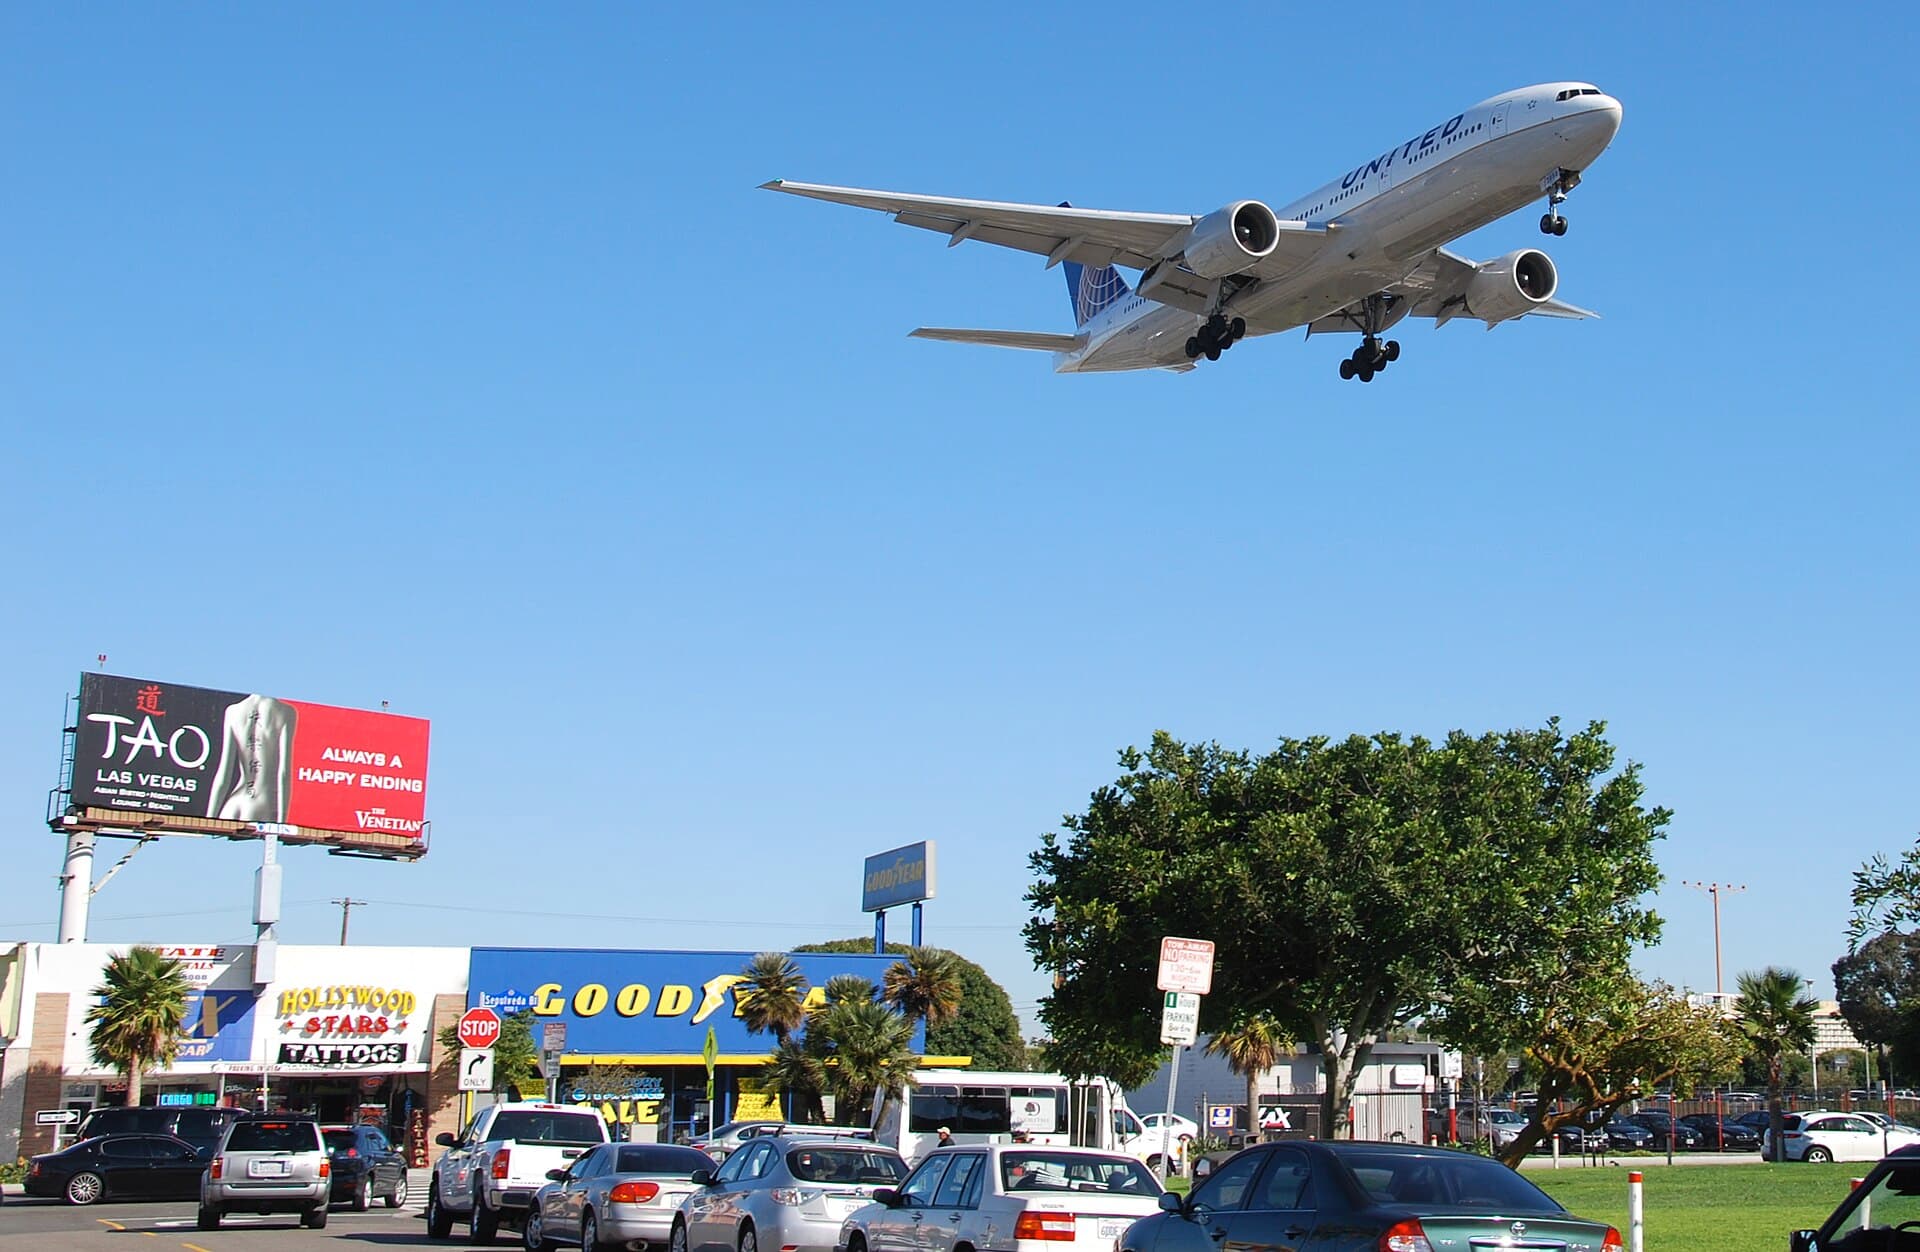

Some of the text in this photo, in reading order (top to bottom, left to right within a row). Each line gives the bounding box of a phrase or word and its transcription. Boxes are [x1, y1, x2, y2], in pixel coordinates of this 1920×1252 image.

[1341, 113, 1464, 190] UNITED
[136, 685, 166, 716] 道
[321, 747, 403, 769] ALWAYS A
[96, 769, 198, 792] LAS VEGAS
[298, 767, 423, 793] HAPPY ENDING
[355, 810, 423, 832] VENETIAN
[1164, 949, 1178, 961] NO
[281, 984, 416, 1015] HOLLYWOOD
[485, 995, 526, 1007] Sepulveda
[306, 1015, 389, 1033] STARS
[461, 1020, 498, 1036] STOP
[285, 1044, 401, 1063] TATTOOS
[463, 1079, 487, 1087] ONLY
